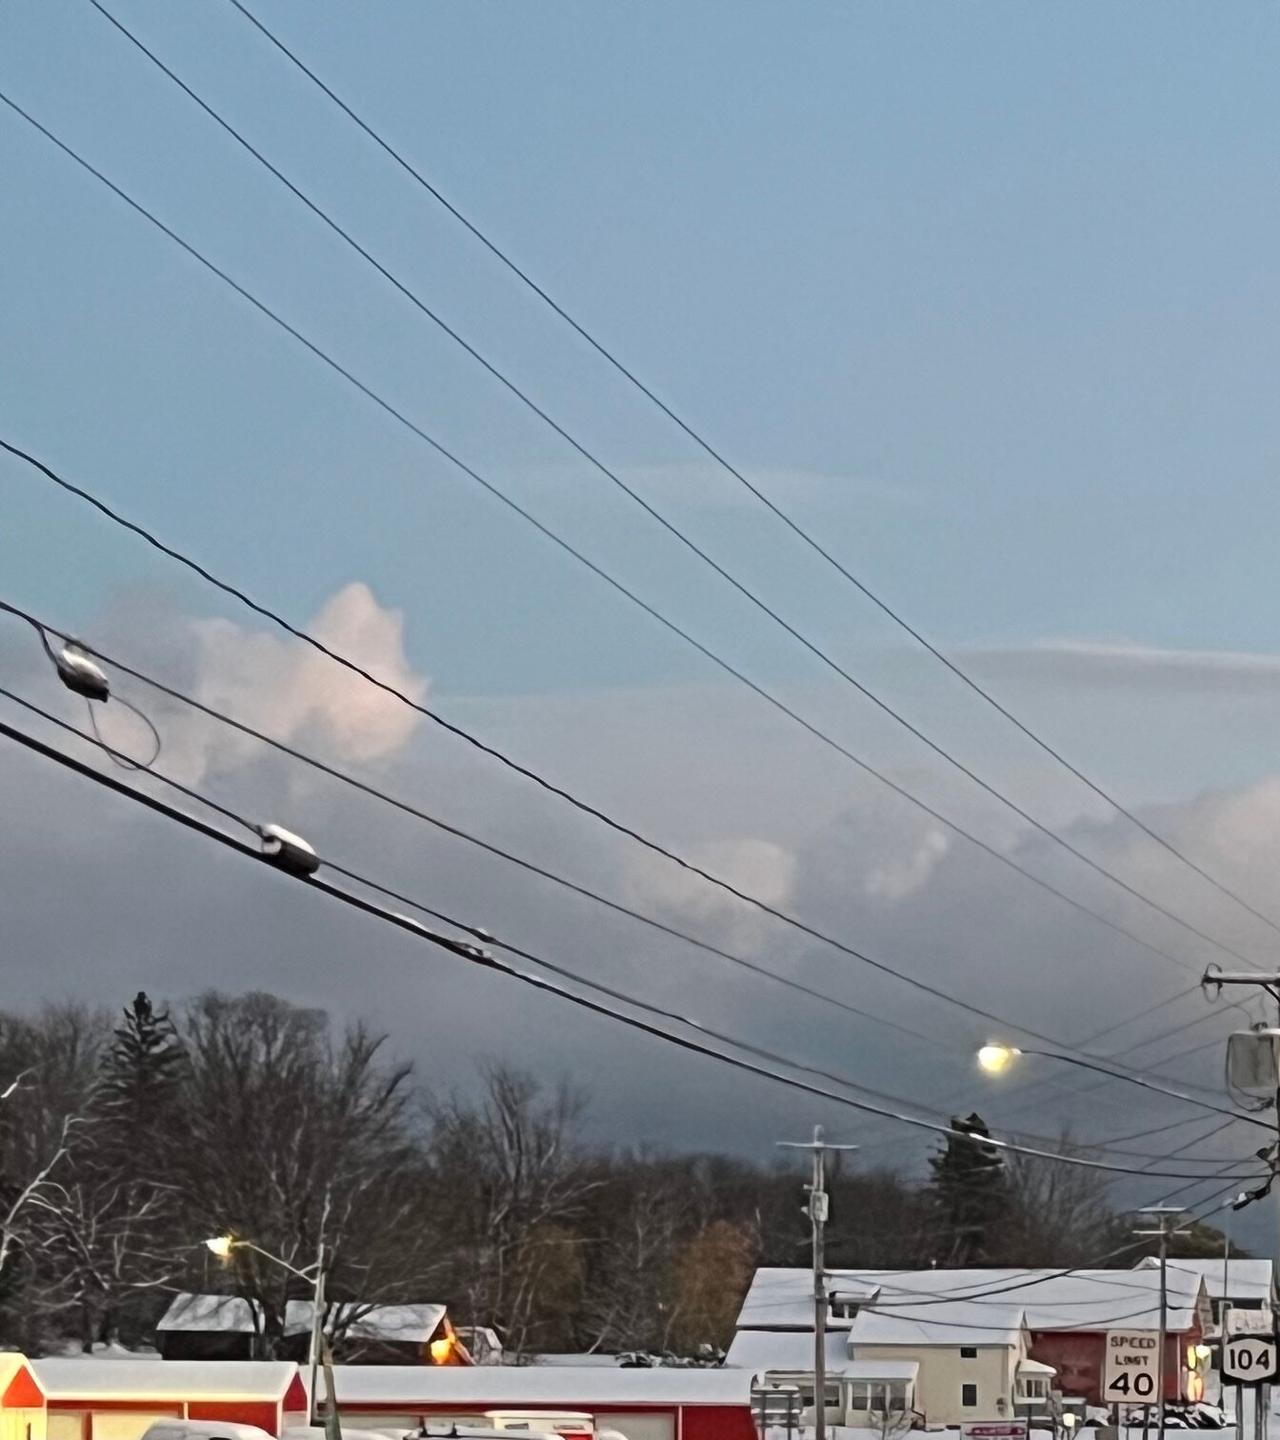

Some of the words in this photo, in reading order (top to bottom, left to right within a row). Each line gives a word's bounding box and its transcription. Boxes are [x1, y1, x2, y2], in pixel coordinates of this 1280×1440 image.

[1110, 1336, 1156, 1349] SPEED
[1115, 1355, 1149, 1366] LIMIT
[1230, 1348, 1270, 1371] 104
[1109, 1372, 1154, 1396] 40
